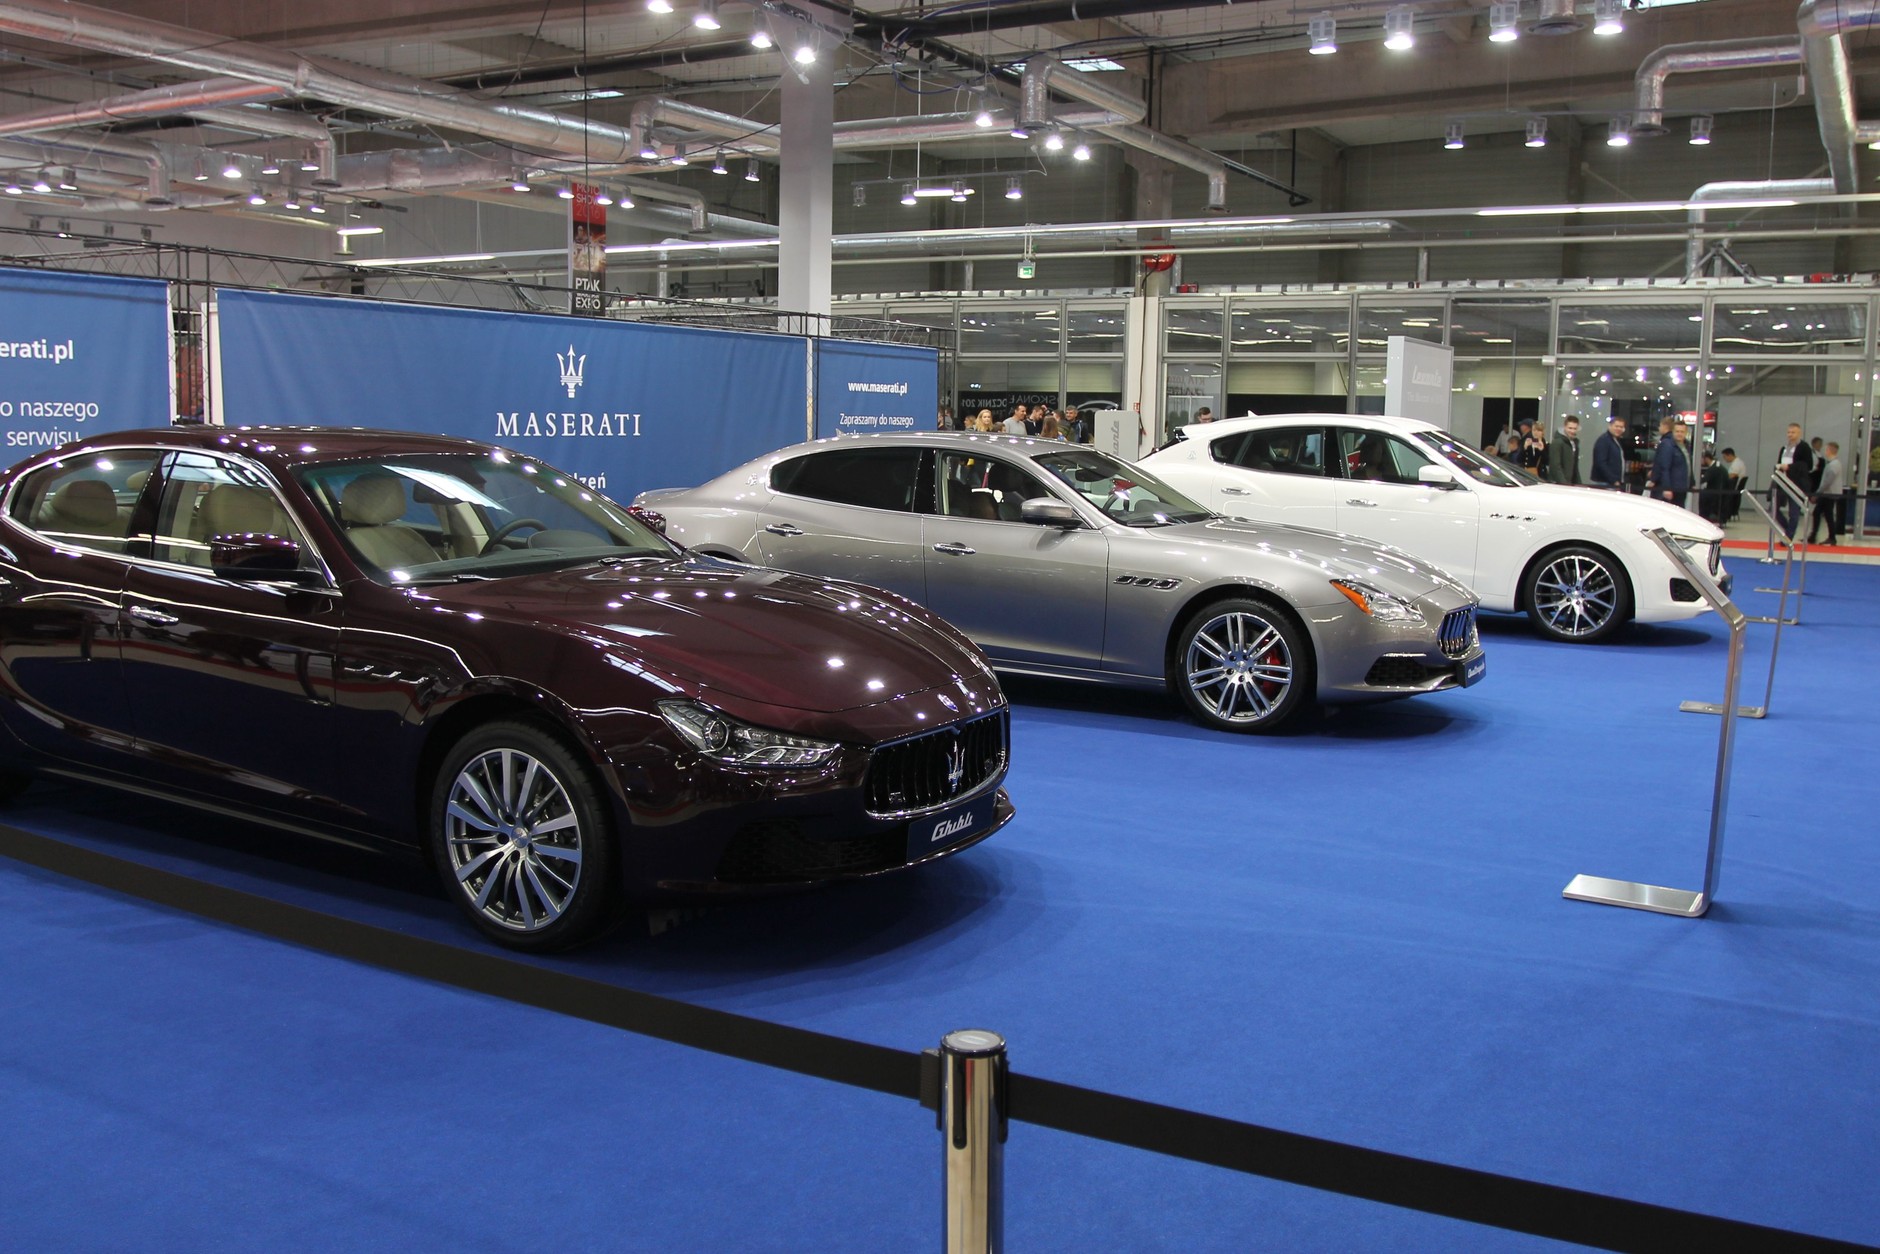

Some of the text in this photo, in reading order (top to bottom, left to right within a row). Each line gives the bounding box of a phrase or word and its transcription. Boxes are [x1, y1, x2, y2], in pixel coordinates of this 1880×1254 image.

[576, 183, 600, 195] MOTO
[576, 193, 599, 206] SHOW
[575, 277, 600, 292] PTAK
[575, 297, 601, 310] EXPO
[0, 339, 74, 364] erati.pl
[848, 382, 908, 396] www.maserati.pl
[20, 402, 99, 422] naszego
[495, 412, 641, 437] MASERATI
[840, 413, 914, 428] Zapraszamy do naszego
[931, 812, 973, 842] Ghibli
